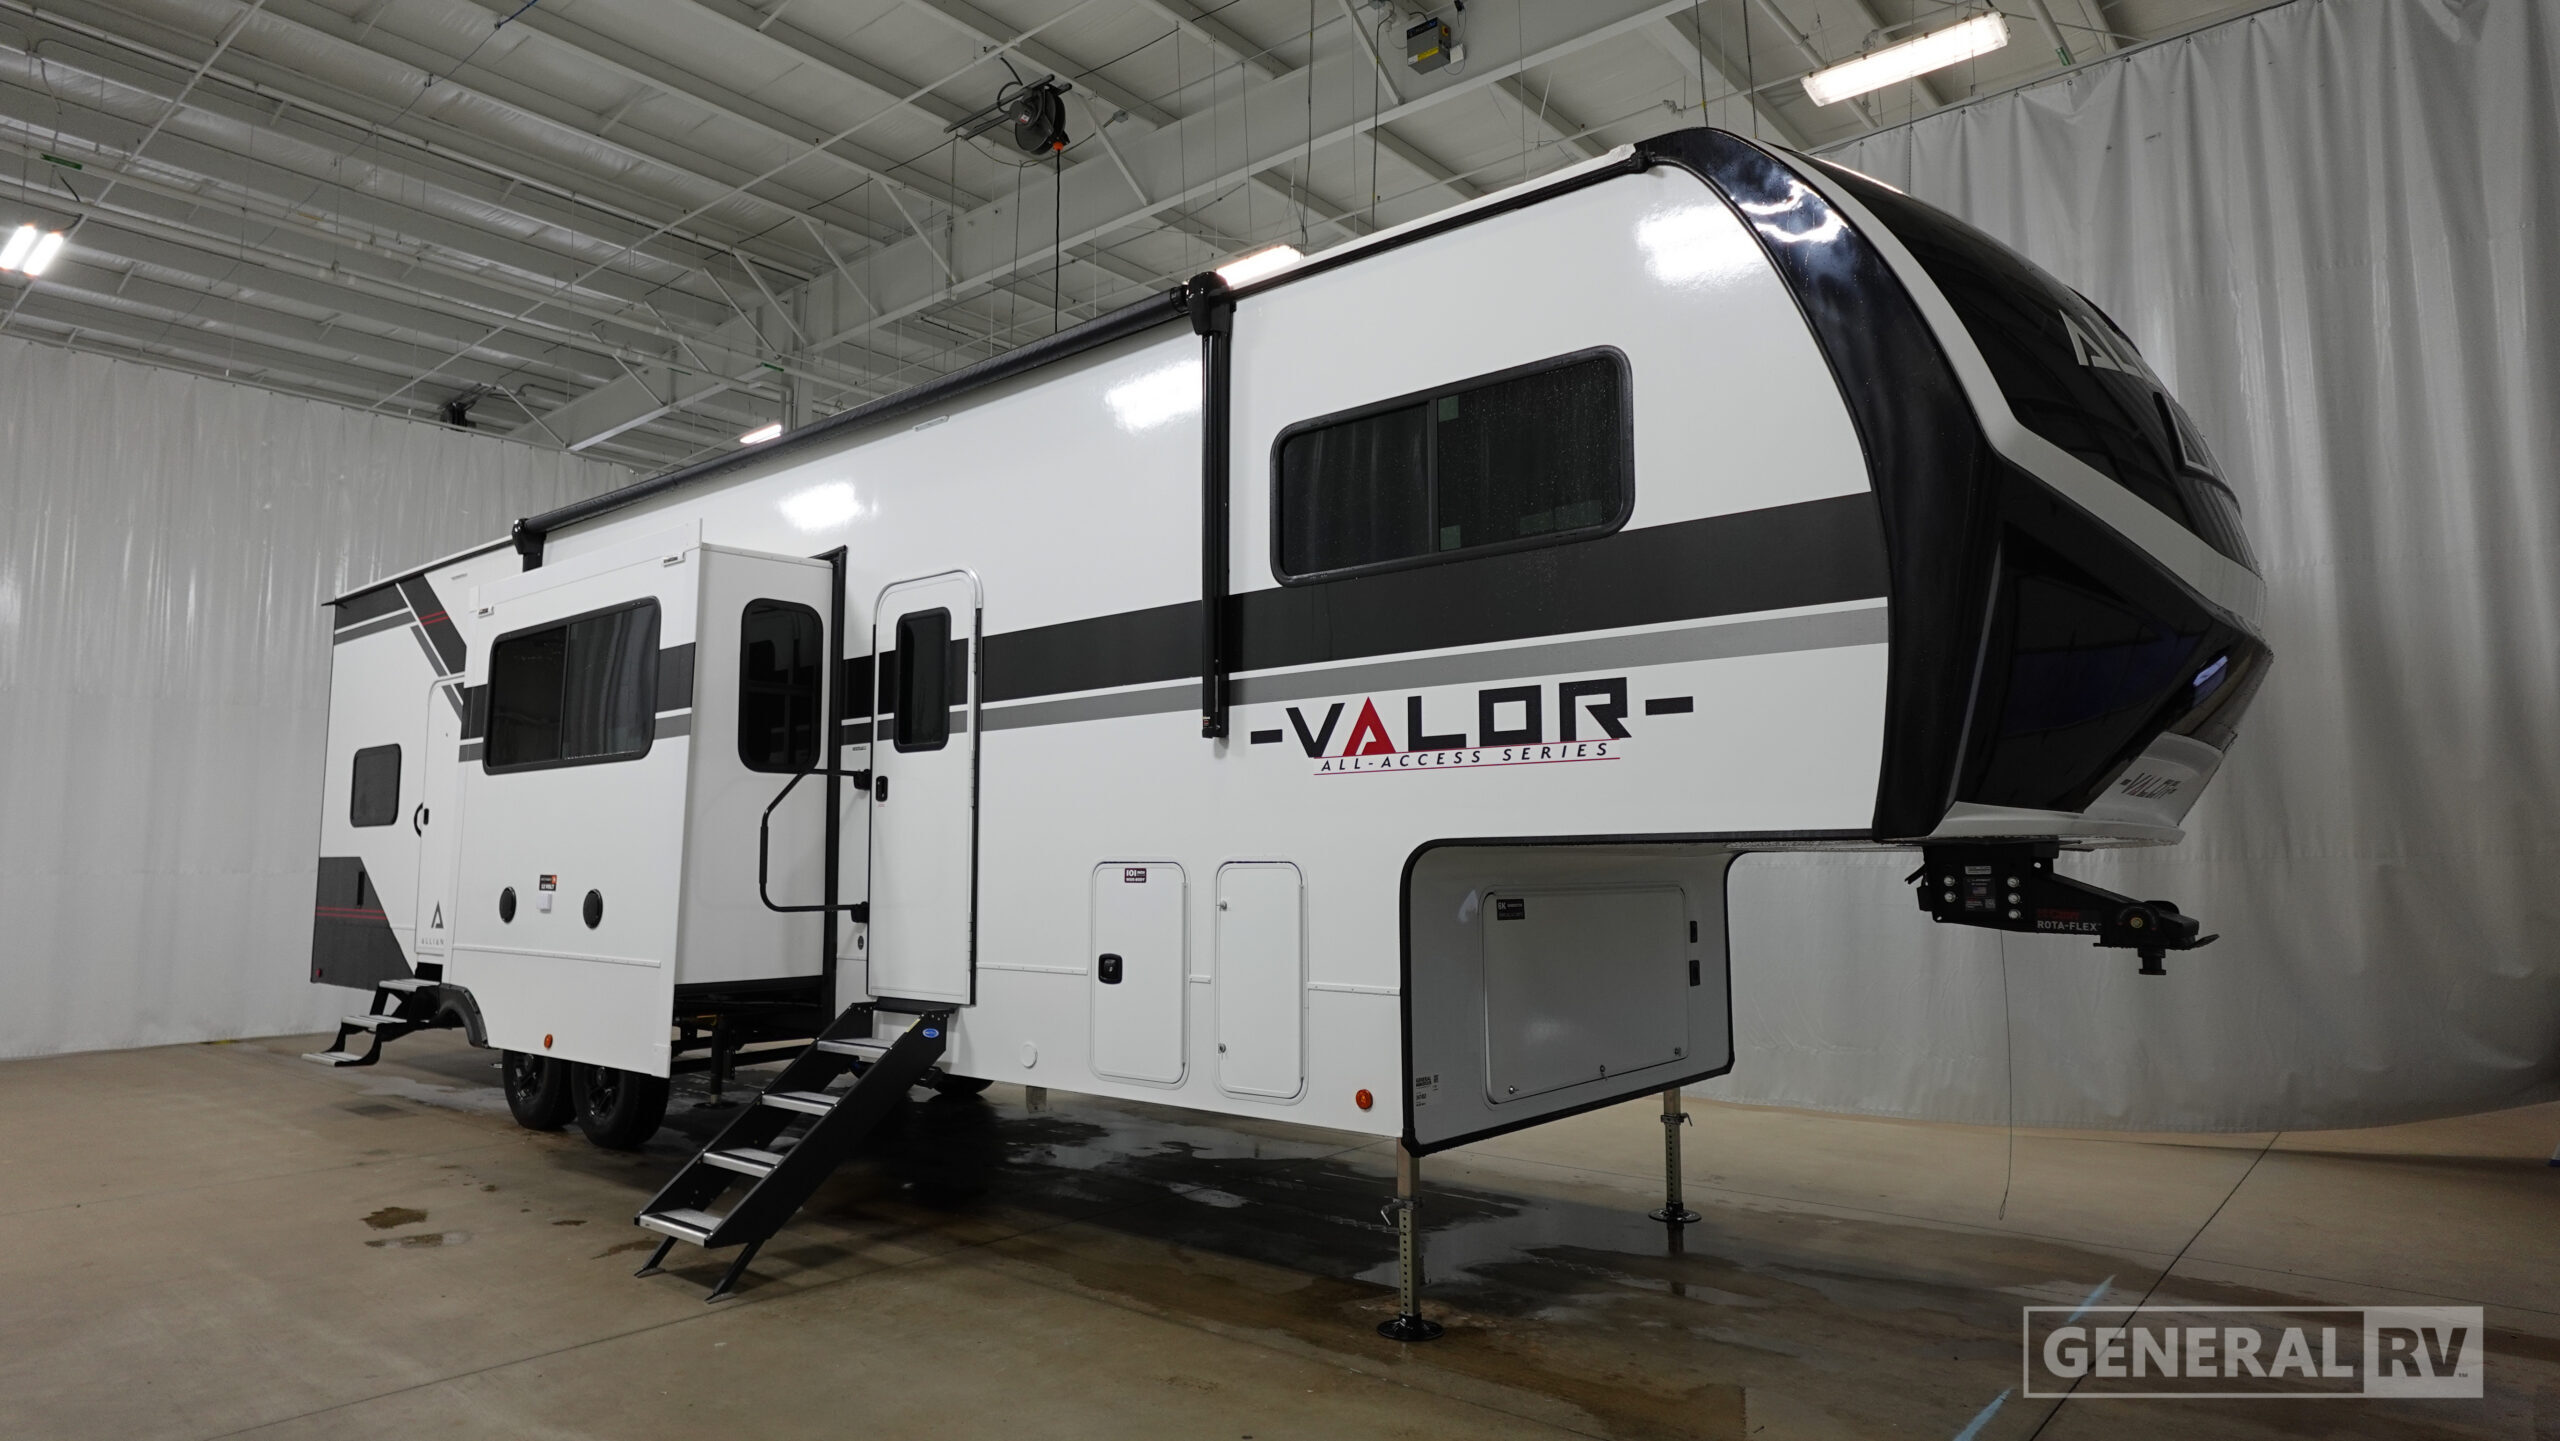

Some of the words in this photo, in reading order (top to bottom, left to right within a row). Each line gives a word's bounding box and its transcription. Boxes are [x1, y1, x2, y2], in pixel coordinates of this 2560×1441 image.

[1285, 677, 1632, 758] VALOR
[1321, 750, 1481, 772] ALL-ACCESS
[1502, 742, 1607, 761] SERIES
[2037, 920, 2098, 932] ROTA-FLEX
